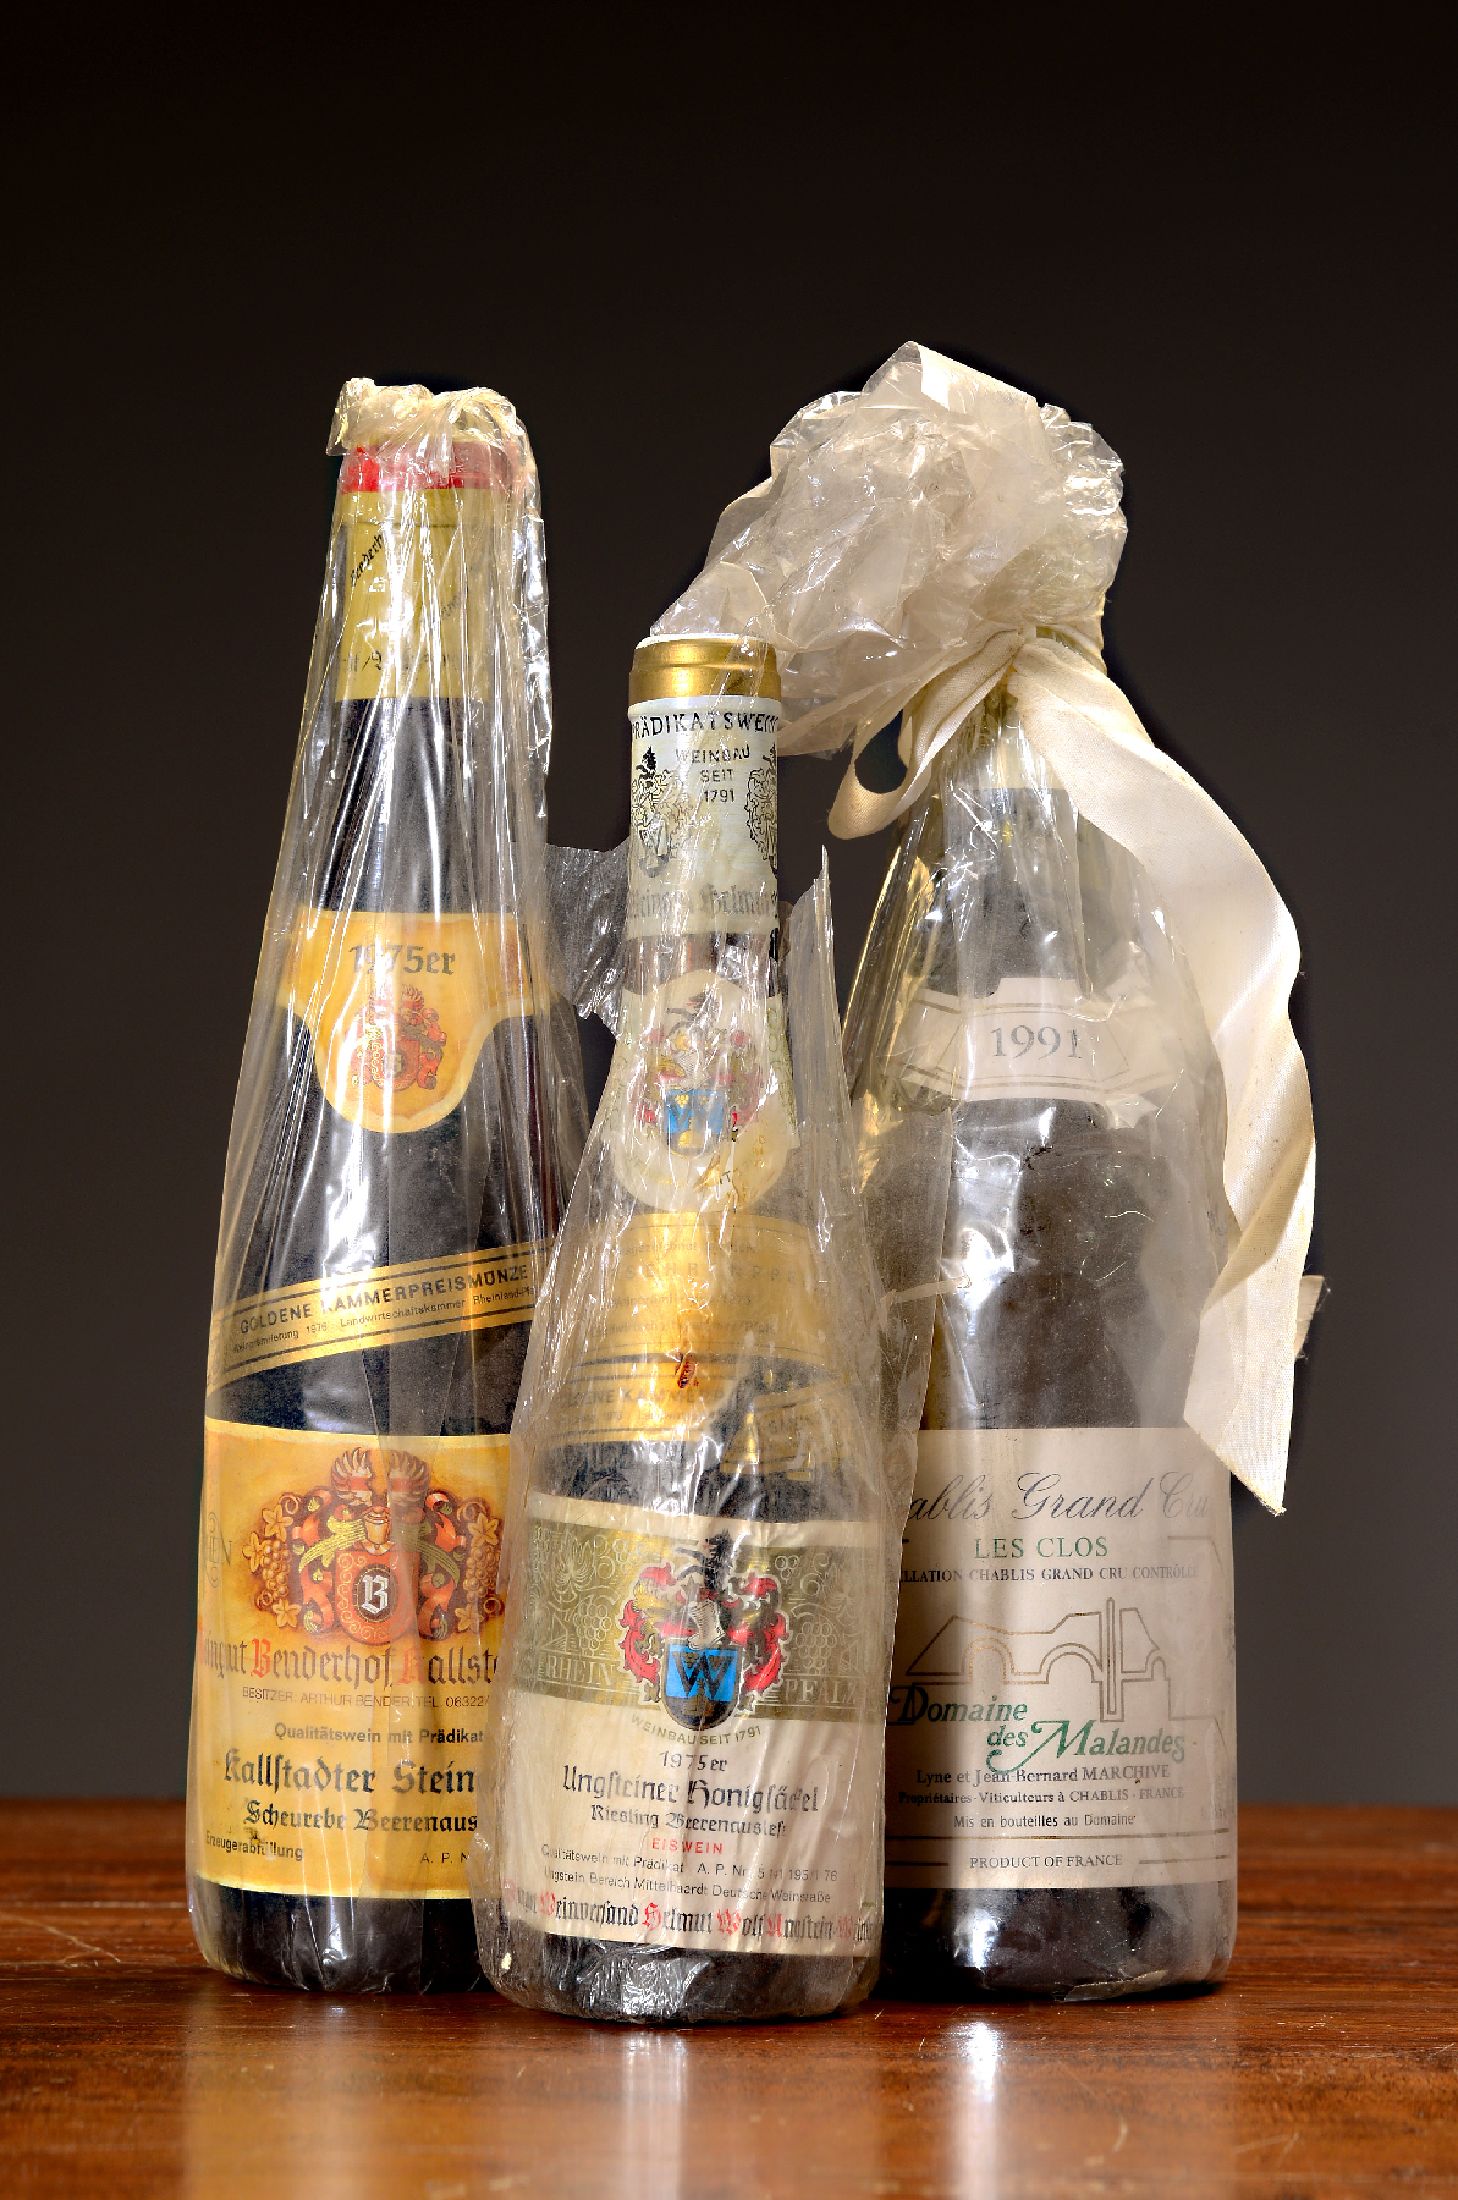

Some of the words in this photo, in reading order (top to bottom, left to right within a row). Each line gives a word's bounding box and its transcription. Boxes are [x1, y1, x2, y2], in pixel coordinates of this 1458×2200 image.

[700, 768, 735, 783] SEIT
[704, 788, 735, 803] 1791
[990, 1024, 1083, 1061] 1991
[240, 1303, 313, 1335] GOLDENE
[1011, 1472, 1155, 1520] Grand
[1160, 1471, 1210, 1519] Cru
[975, 1537, 1024, 1559] LES
[1036, 1536, 1109, 1558] CLOS
[969, 1568, 1035, 1582] CHABLIS
[1041, 1567, 1094, 1581] GRAND
[1100, 1567, 1127, 1580] CRU
[301, 1692, 356, 1706] ARTHUR
[357, 1694, 410, 1707] BENDER
[889, 1684, 1028, 1727] Domaine
[274, 1721, 381, 1744] Qualitätswein
[388, 1729, 413, 1744] mit
[418, 1728, 484, 1744] Prädikat
[631, 1714, 697, 1745] WEINBAU
[700, 1733, 732, 1745] SEIT
[736, 1725, 761, 1742] 1791
[987, 1724, 1029, 1748] des
[986, 1719, 1185, 1775] Malandes
[659, 1750, 728, 1773] 1975er
[916, 1769, 952, 1788] Lyne
[957, 1771, 970, 1784] et
[1083, 1764, 1171, 1781] MARCHIVE
[1057, 1790, 1066, 1803] à
[1069, 1788, 1129, 1803] CHABLIS
[1138, 1787, 1185, 1800] FRANCE
[244, 1799, 346, 1832] Scheurebe
[591, 1804, 660, 1829] Riesling
[953, 1815, 974, 1828] Mis
[981, 1817, 995, 1828] en
[1000, 1815, 1058, 1828] bouteilles
[1064, 1816, 1079, 1827] au
[1084, 1814, 1135, 1827] Domaine
[652, 1837, 723, 1854] EISWEIN
[420, 1852, 434, 1864] A.
[441, 1852, 453, 1864] P.
[633, 1856, 684, 1873] Prädikat
[697, 1862, 711, 1875] A.
[969, 1856, 1040, 1869] PRODUCT
[1044, 1855, 1063, 1868] OF
[1066, 1854, 1123, 1867] FRANCE
[589, 1871, 630, 1889] Bereich
